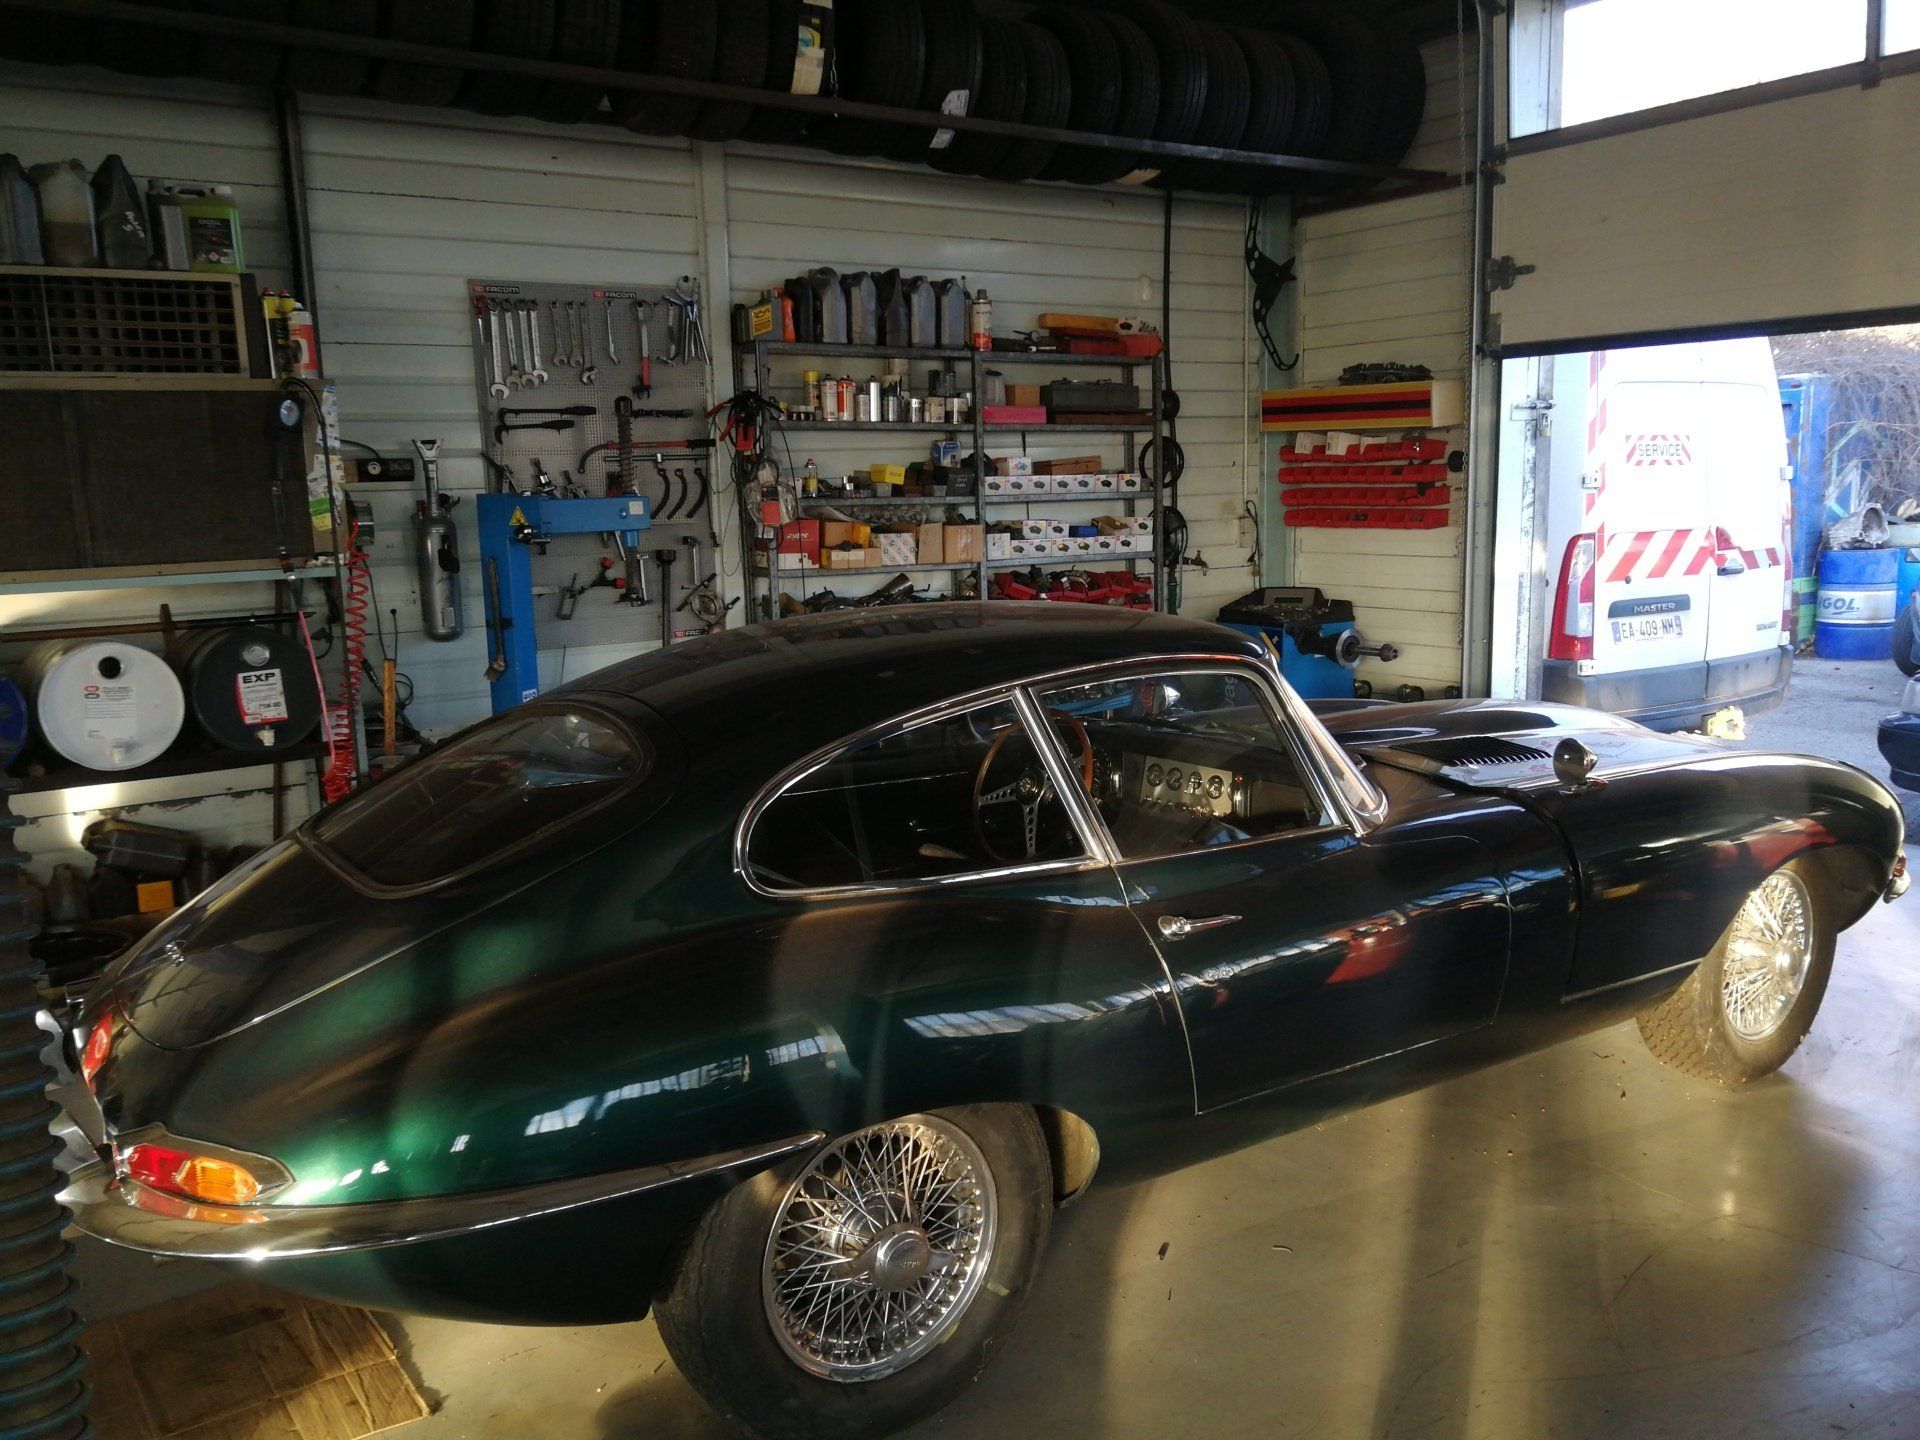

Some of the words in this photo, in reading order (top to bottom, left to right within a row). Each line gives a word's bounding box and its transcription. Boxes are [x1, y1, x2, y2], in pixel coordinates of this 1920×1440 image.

[605, 291, 636, 299] FACOM
[1638, 443, 1681, 457] SERVICE
[1633, 602, 1676, 613] MASTER
[242, 672, 276, 684] EXP
